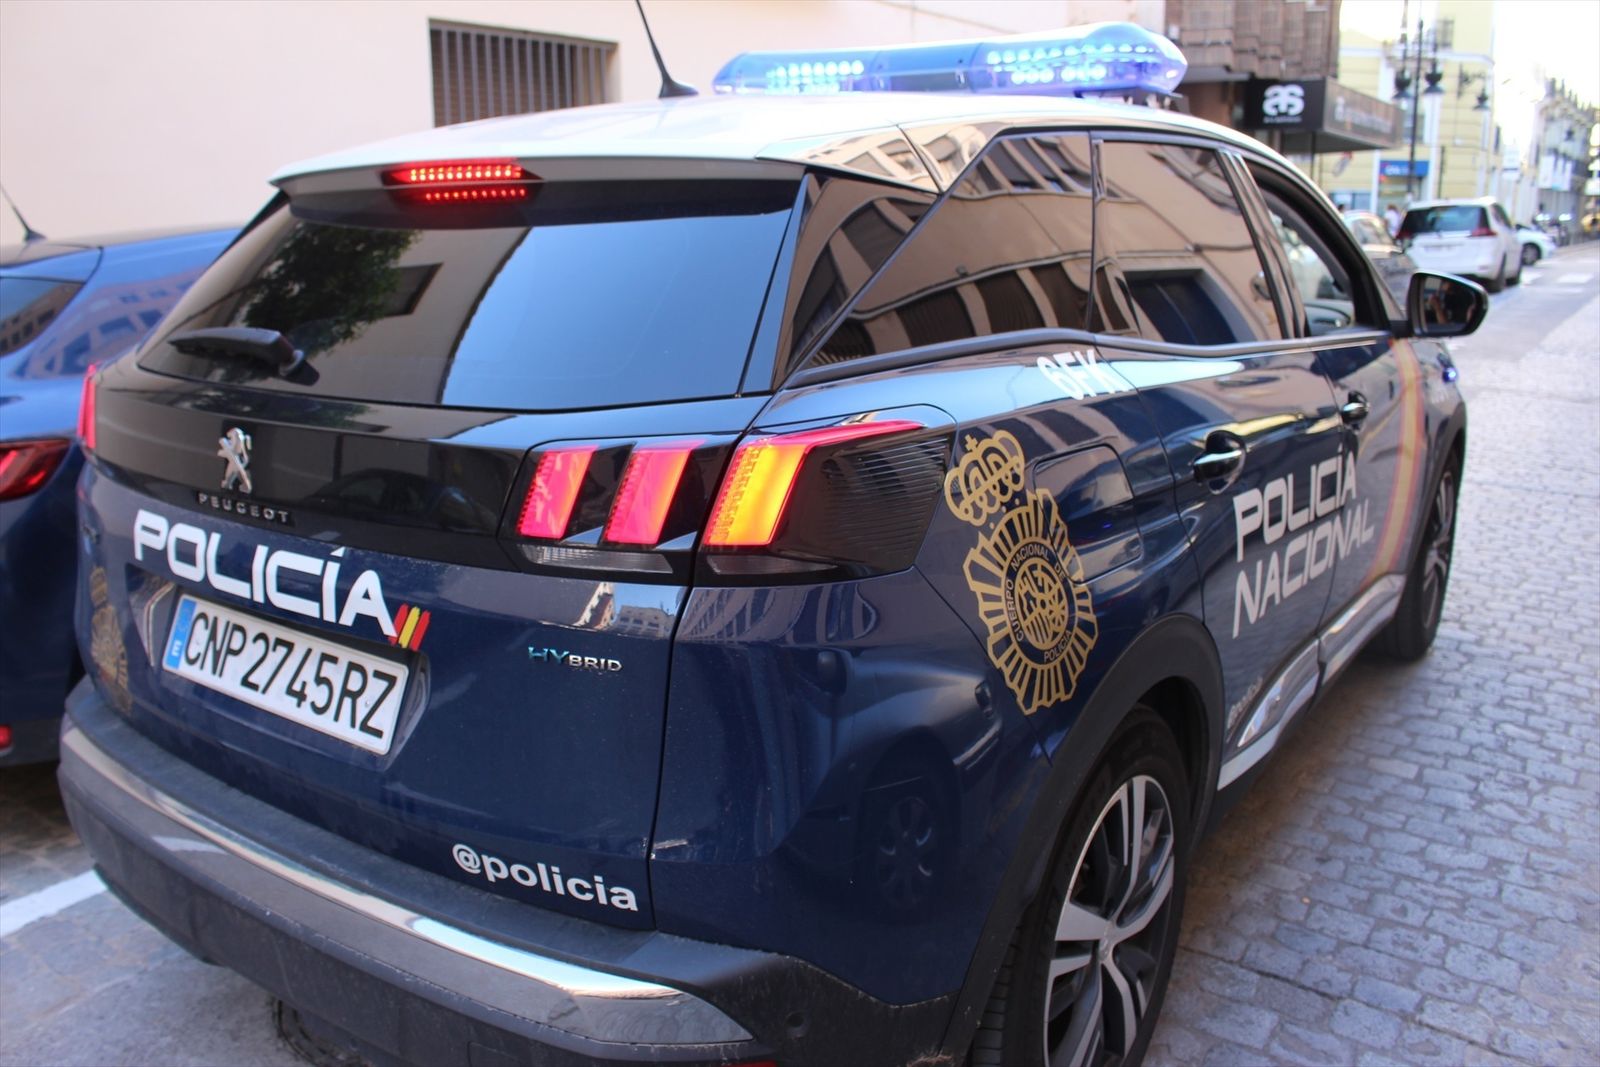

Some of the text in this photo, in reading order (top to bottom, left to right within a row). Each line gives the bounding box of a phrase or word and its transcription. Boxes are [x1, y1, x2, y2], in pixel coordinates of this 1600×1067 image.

[198, 493, 288, 523] PEUGEOT
[1233, 442, 1357, 563] POLICÍA
[133, 509, 397, 638] POLICÍA
[1011, 543, 1049, 572] NACIONAL
[1054, 561, 1067, 579] DE
[1232, 498, 1375, 639] NACIONAL
[1005, 578, 1025, 642] CUERPO
[171, 612, 397, 739] E CNP2745RZ
[528, 646, 623, 672] HYBRID
[452, 843, 639, 912] @policia
